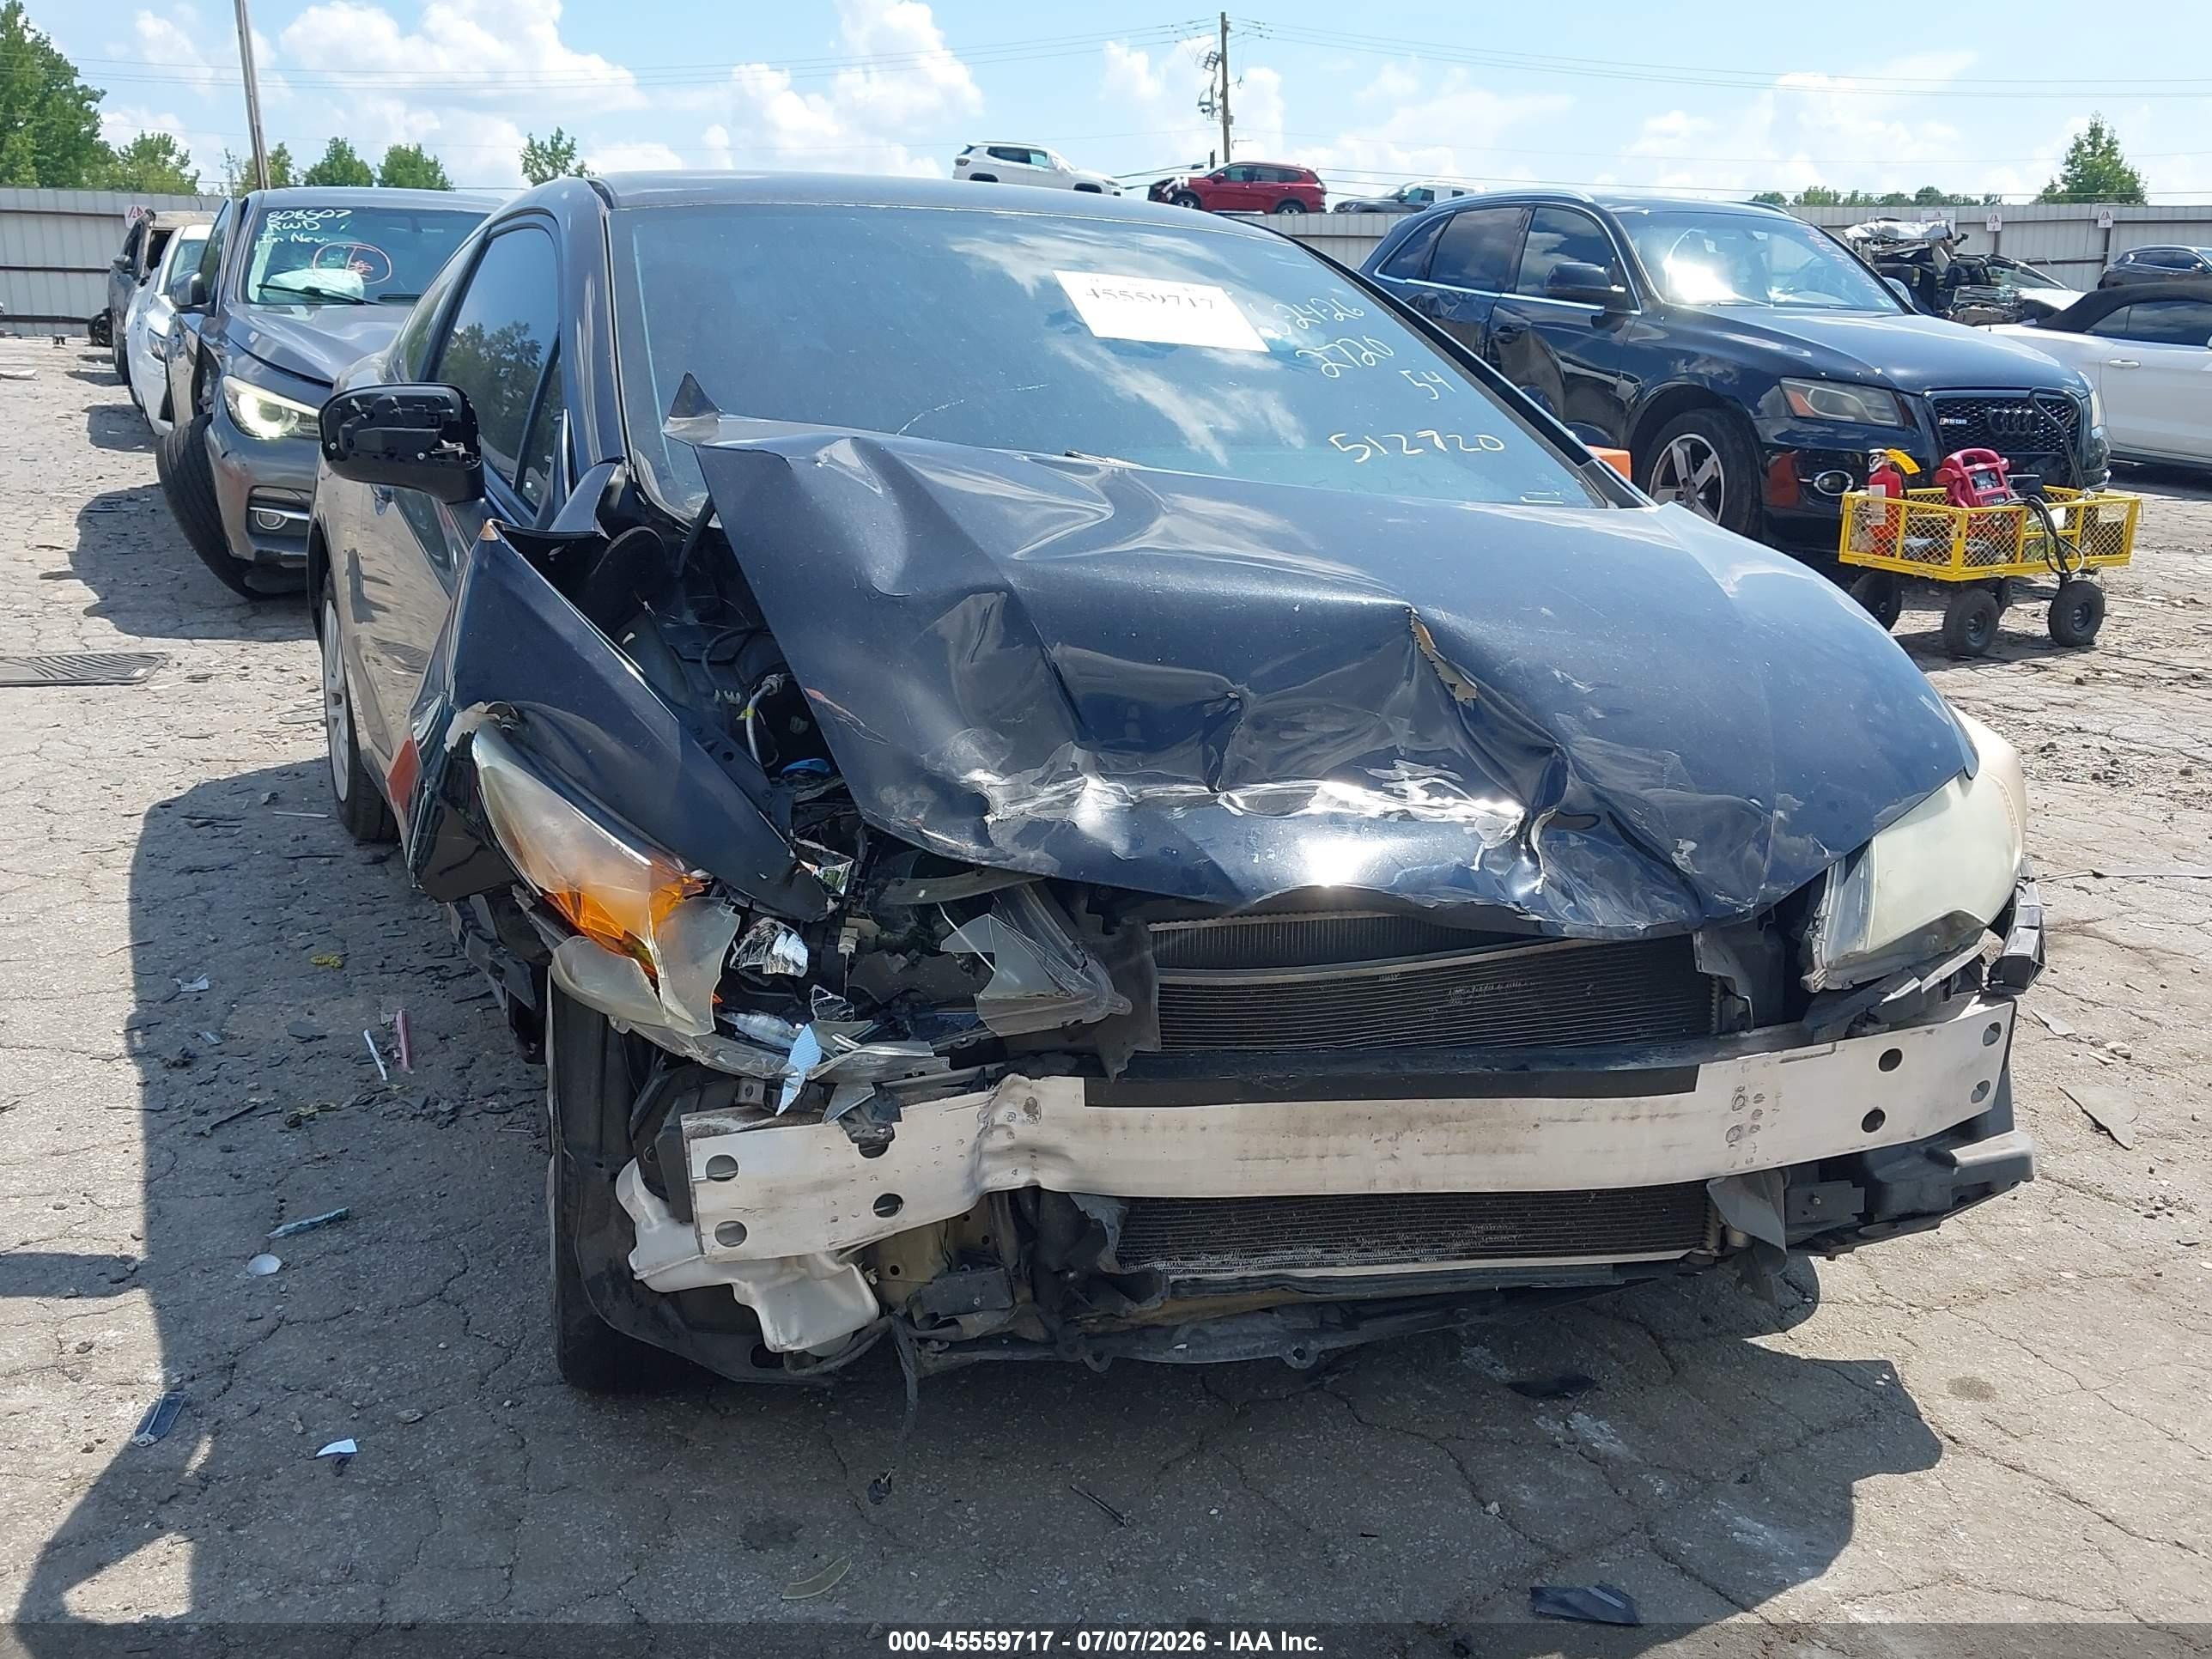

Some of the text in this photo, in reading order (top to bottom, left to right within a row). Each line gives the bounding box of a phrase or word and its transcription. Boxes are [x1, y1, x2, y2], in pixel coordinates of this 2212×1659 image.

[266, 220, 320, 231] RWD
[1295, 335, 1395, 379] 2720
[1399, 369, 1457, 400] 54
